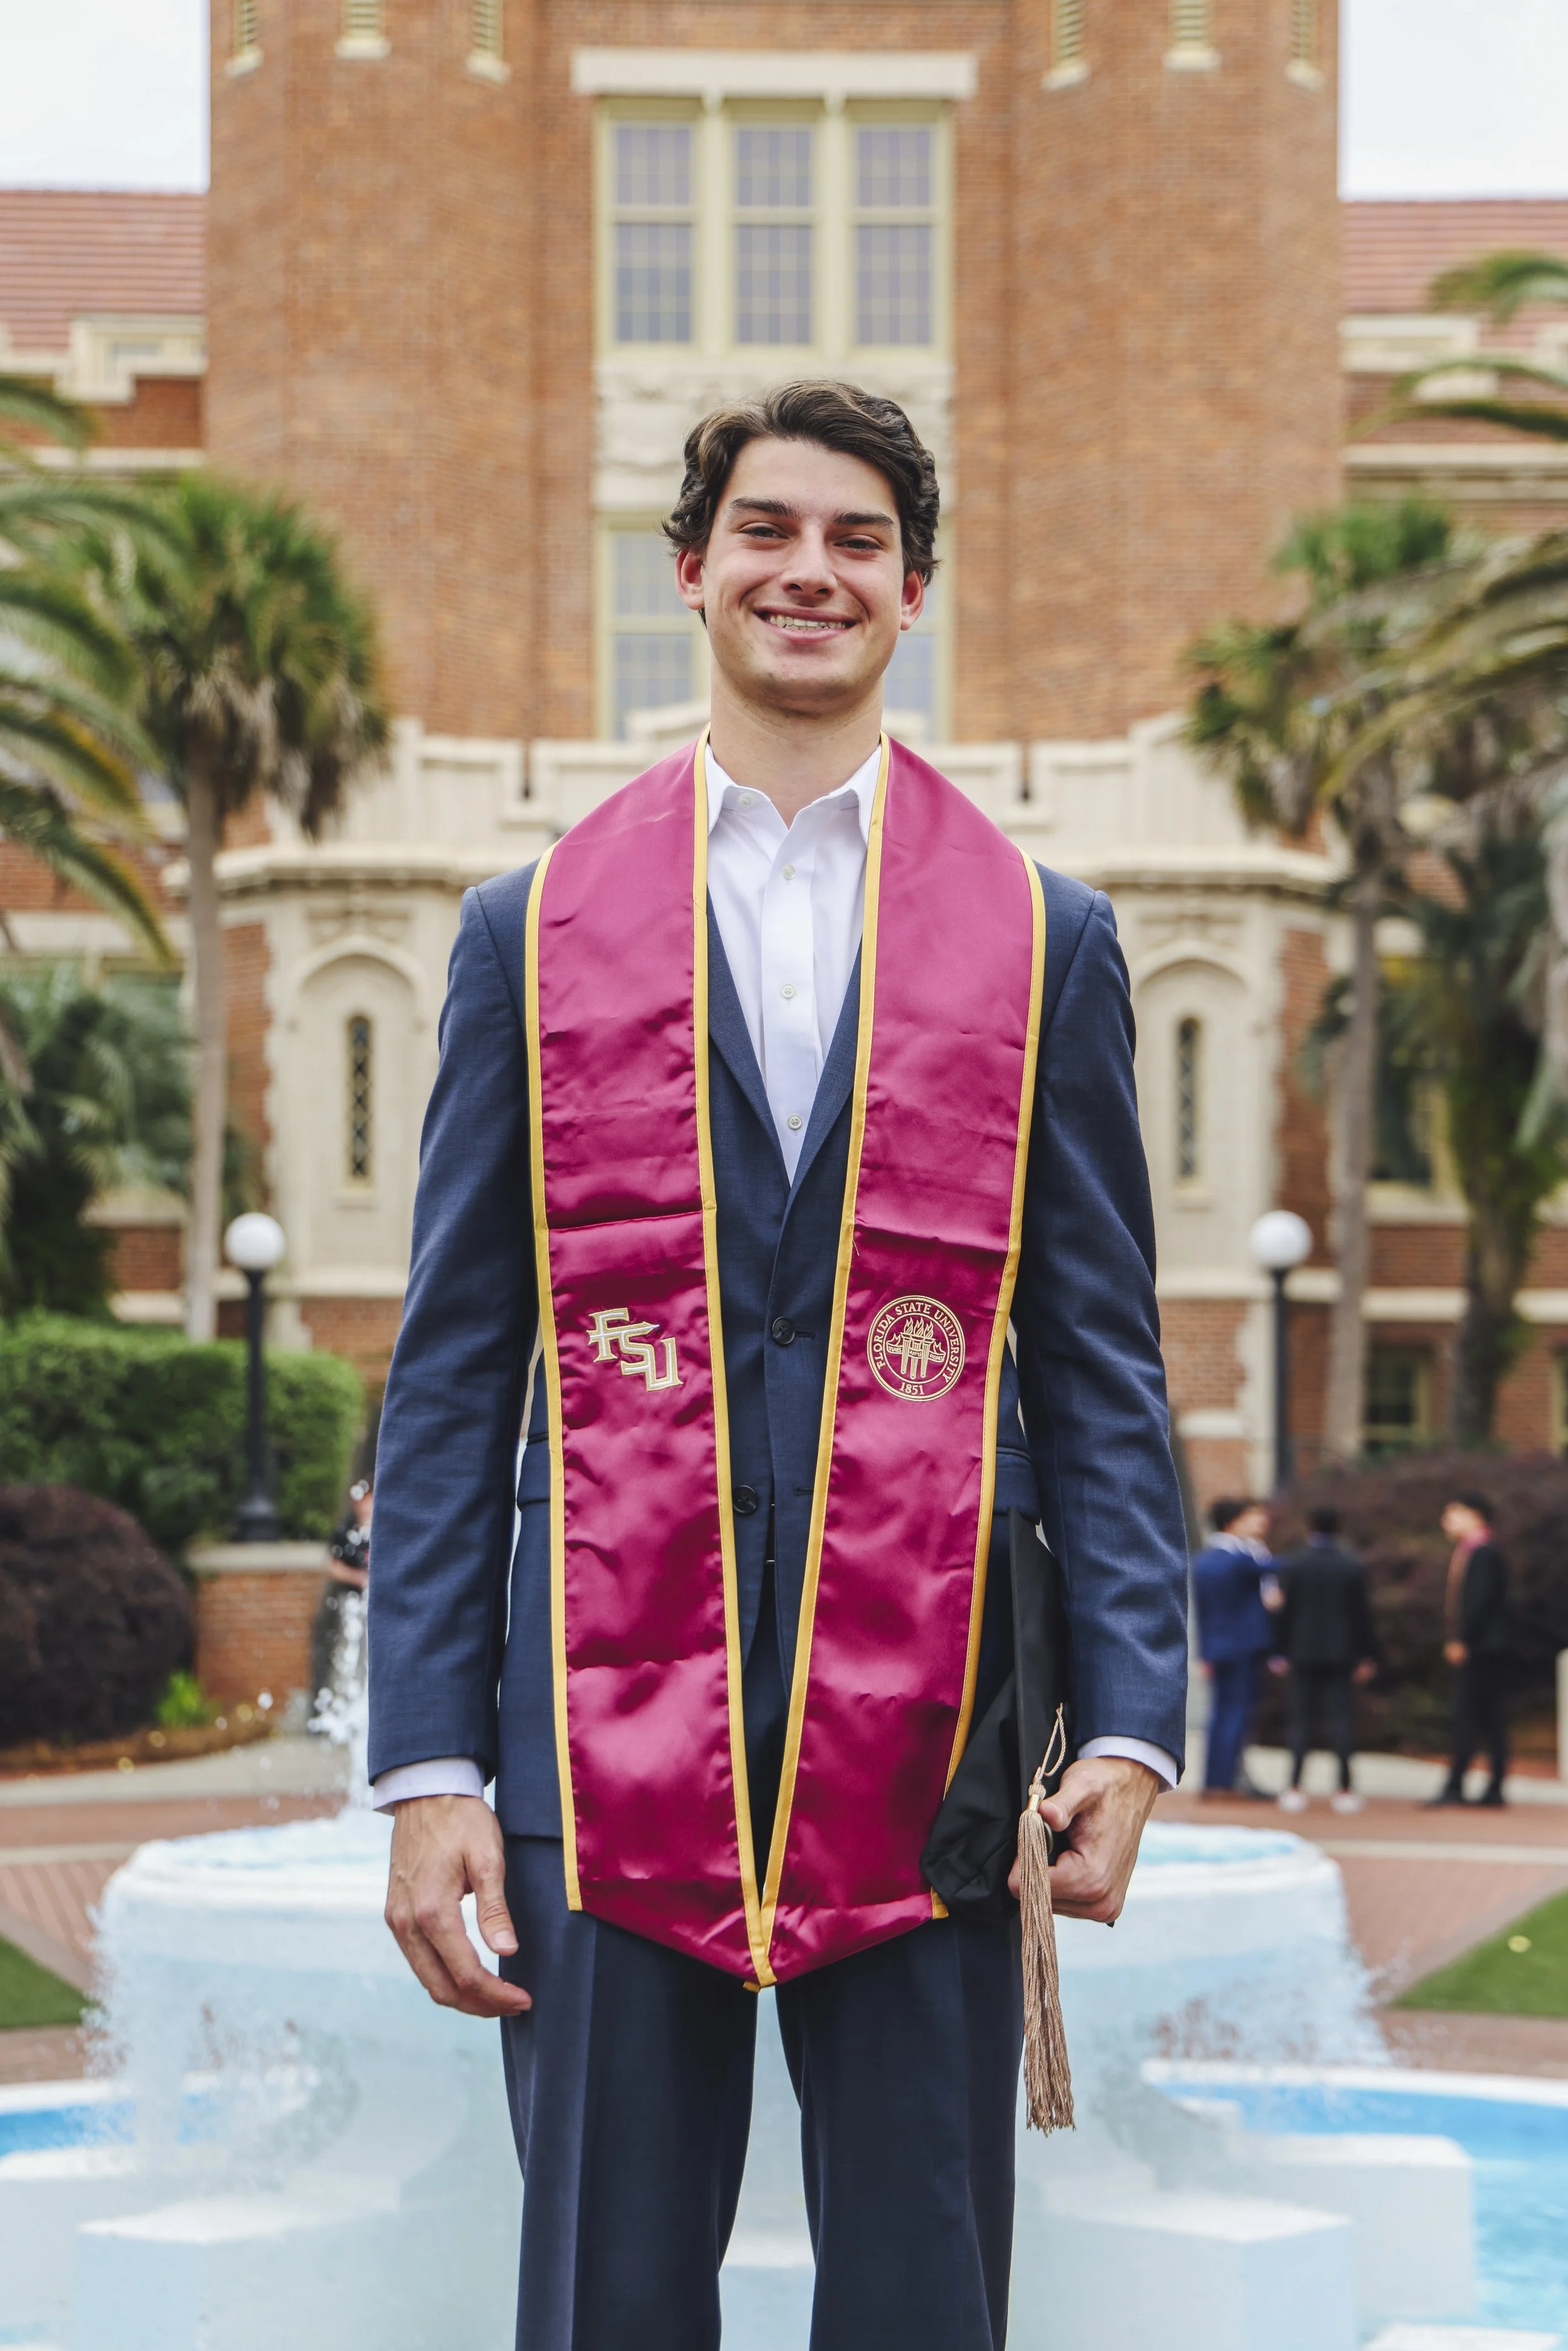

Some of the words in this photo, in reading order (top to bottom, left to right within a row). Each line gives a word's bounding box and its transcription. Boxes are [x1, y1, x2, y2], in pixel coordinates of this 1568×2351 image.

[586, 1307, 684, 1392] FSU
[874, 1314, 895, 1369] FLORIDA
[895, 1302, 931, 1315] STATE
[934, 1310, 960, 1383] UNIVERSITY
[899, 1382, 924, 1395] 1851
